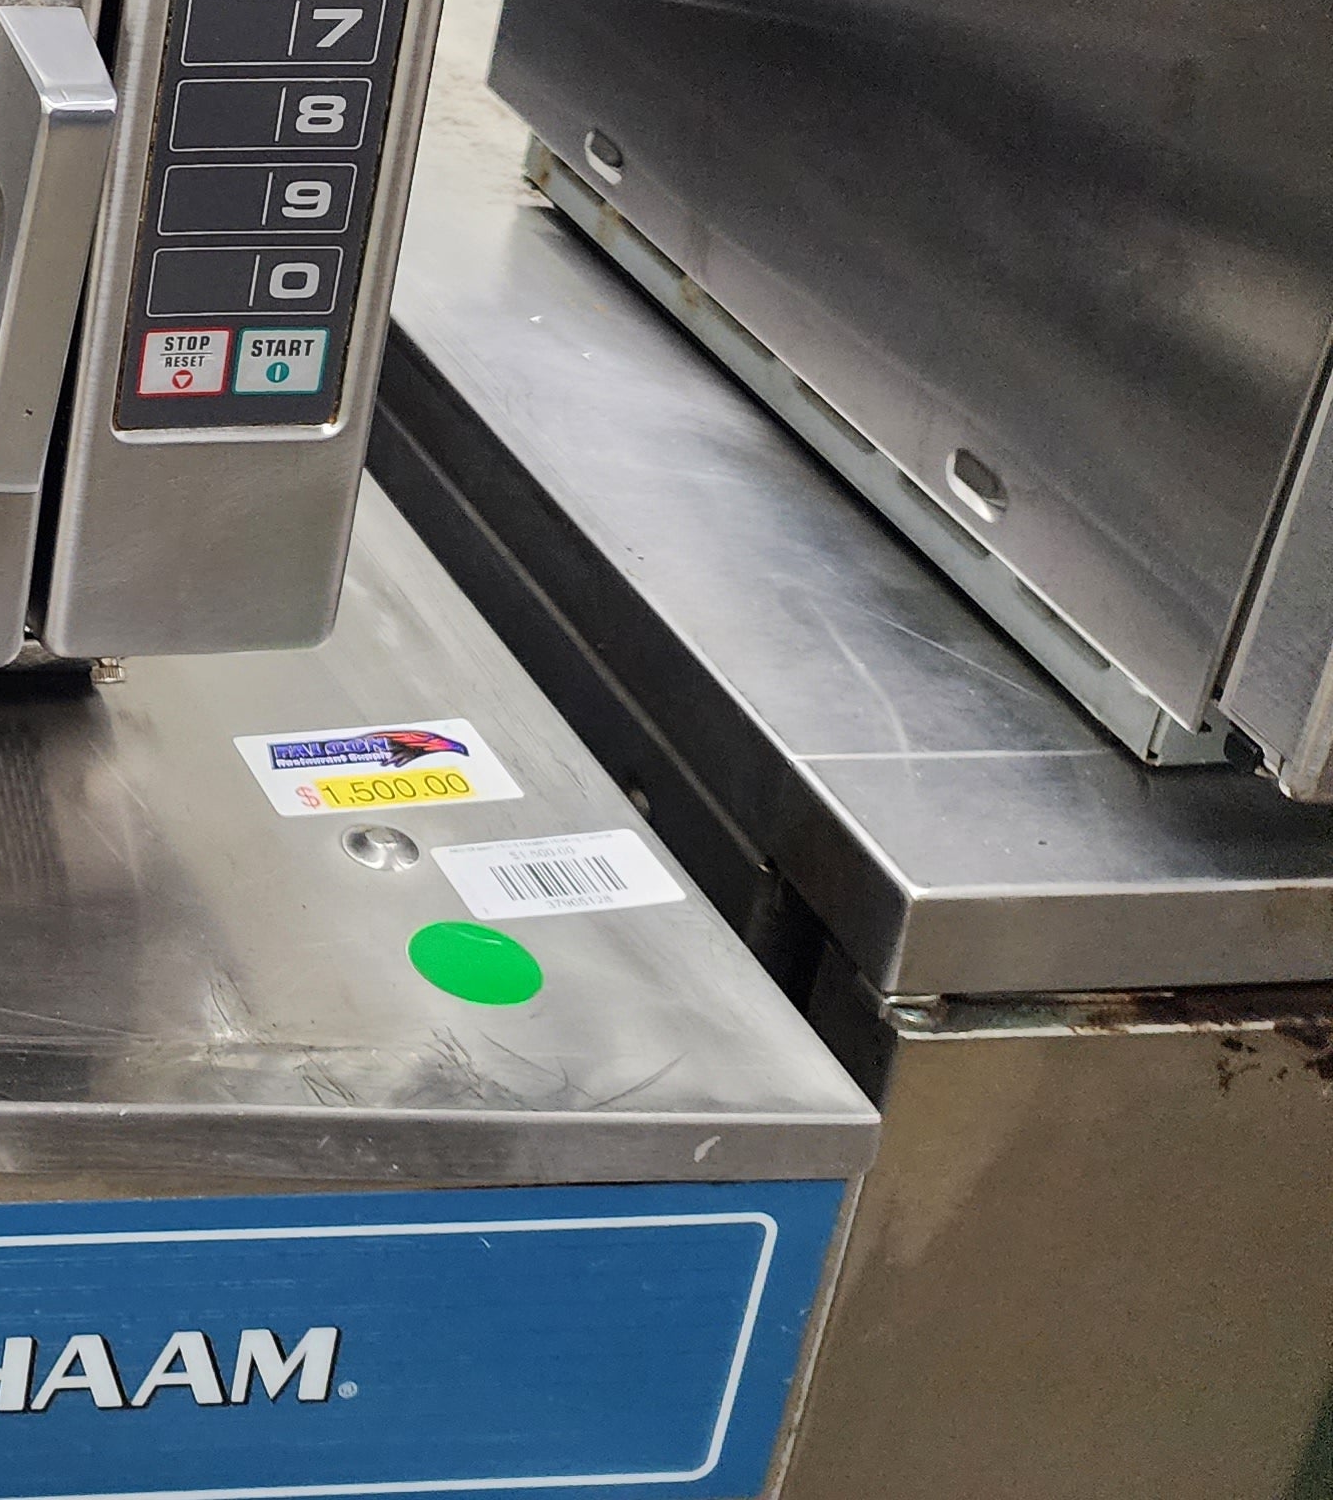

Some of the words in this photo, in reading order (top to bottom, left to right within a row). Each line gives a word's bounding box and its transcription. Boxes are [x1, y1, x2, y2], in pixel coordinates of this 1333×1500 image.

[311, 8, 364, 48] 7
[295, 95, 347, 134] 8
[280, 180, 333, 219] 9
[268, 261, 320, 300] 0
[164, 335, 211, 352] STOP
[164, 355, 206, 369] RESET
[250, 339, 315, 357] START
[295, 772, 471, 809] $1,500.00
